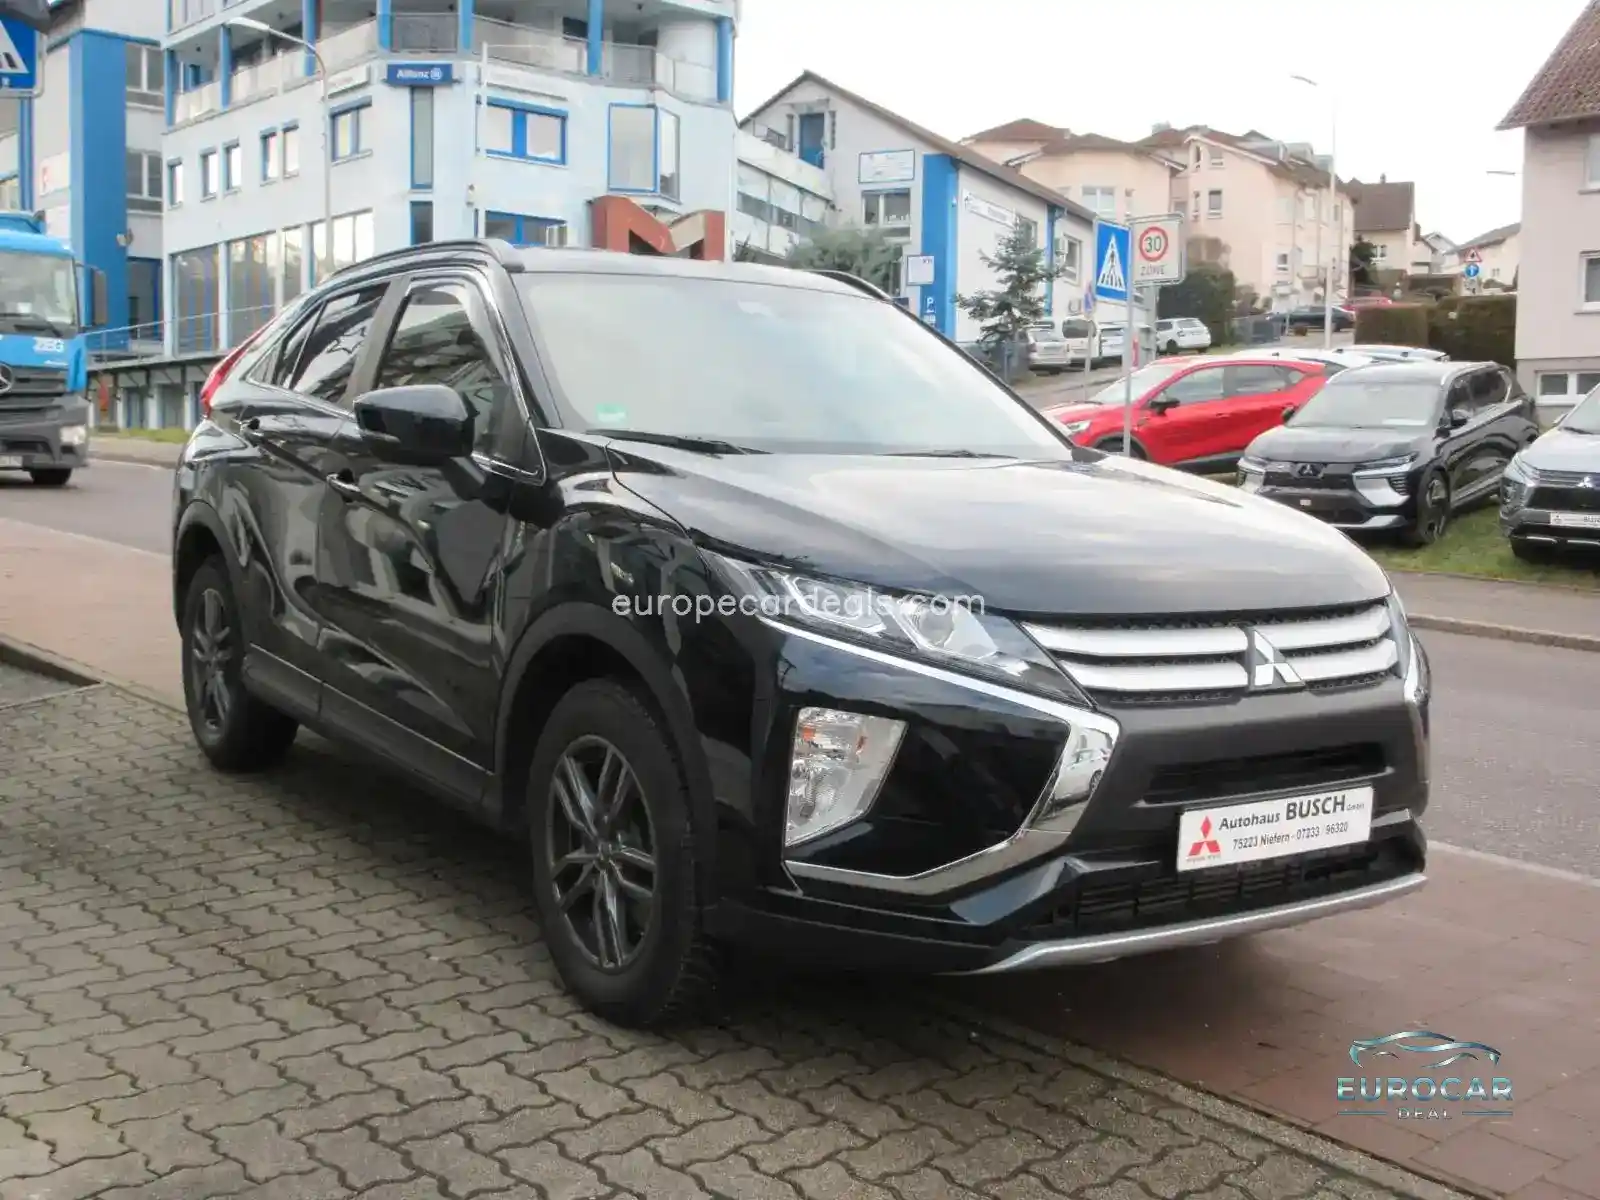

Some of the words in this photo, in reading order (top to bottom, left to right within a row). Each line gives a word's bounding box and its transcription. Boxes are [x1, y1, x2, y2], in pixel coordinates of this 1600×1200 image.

[396, 68, 430, 79] Allianz
[1144, 236, 1162, 253] 30
[1218, 811, 1280, 831] Autohaus
[1285, 794, 1346, 821] BUSCH
[1232, 837, 1259, 850] 75223
[1260, 832, 1290, 846] Niefern
[1296, 828, 1320, 841] 07233
[1325, 821, 1349, 836] 96320
